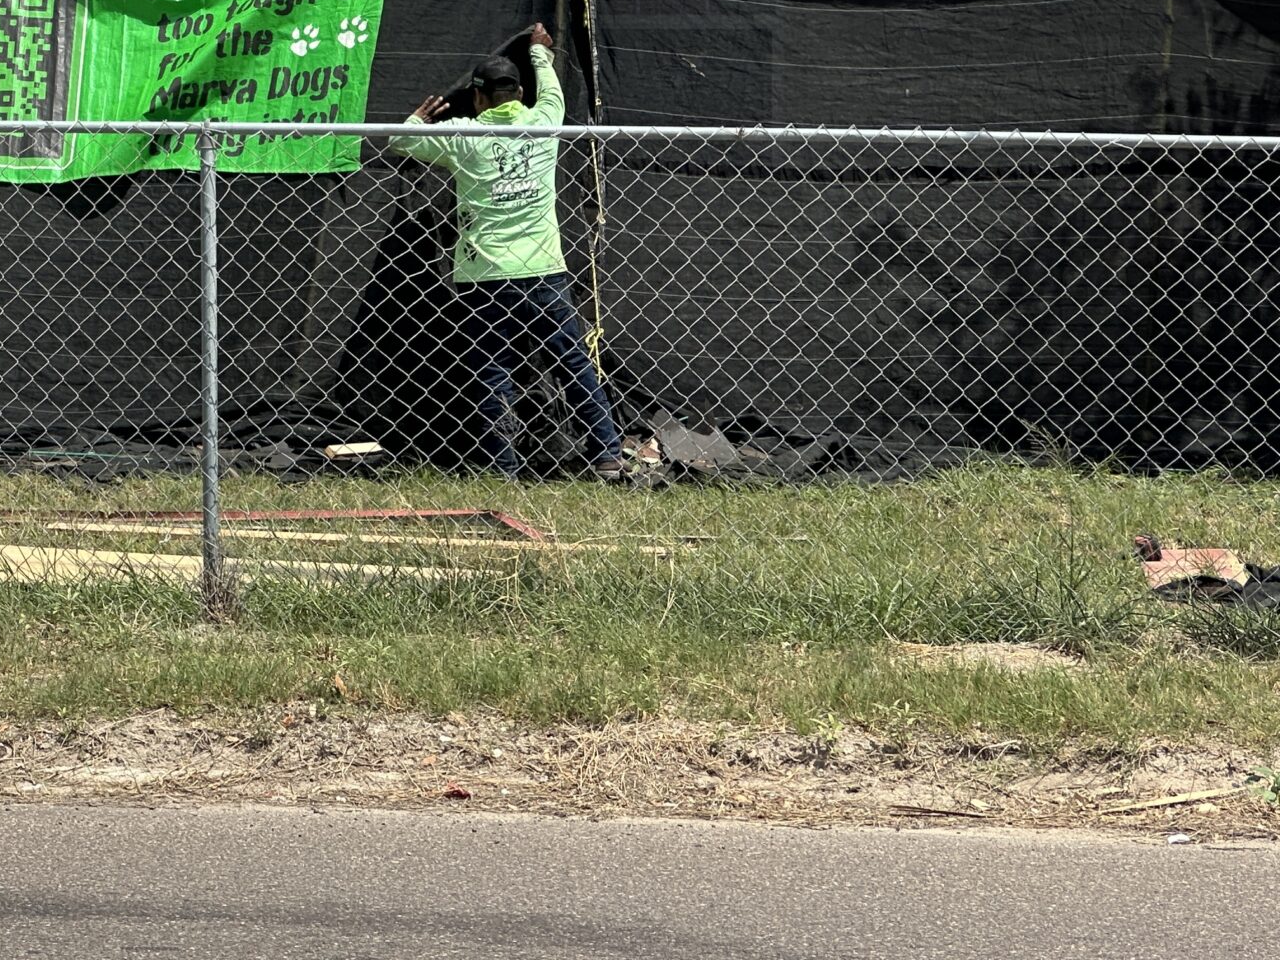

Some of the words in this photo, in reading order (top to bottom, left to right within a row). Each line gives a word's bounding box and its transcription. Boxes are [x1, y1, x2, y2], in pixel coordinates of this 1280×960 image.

[157, 13, 214, 43] too
[157, 42, 207, 81] for
[215, 22, 274, 58] the
[150, 77, 258, 113] Marva
[267, 64, 350, 101] Dogs
